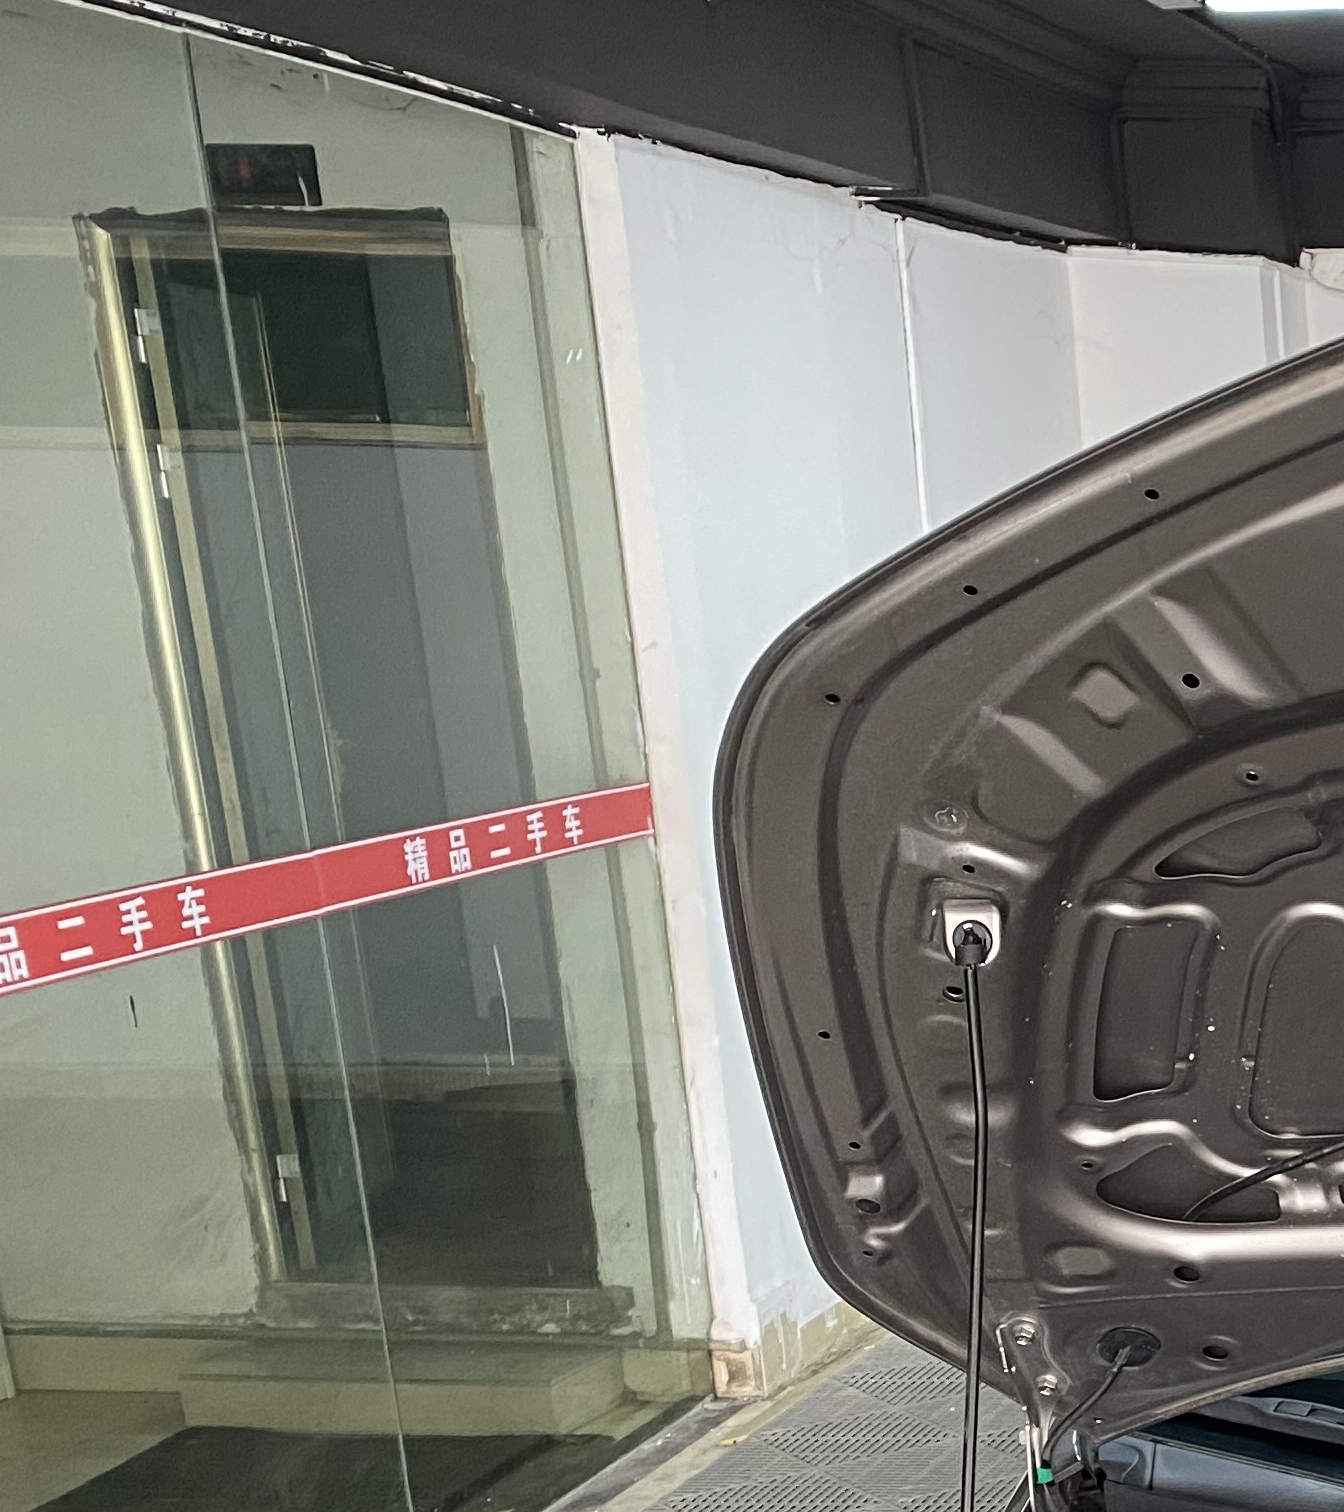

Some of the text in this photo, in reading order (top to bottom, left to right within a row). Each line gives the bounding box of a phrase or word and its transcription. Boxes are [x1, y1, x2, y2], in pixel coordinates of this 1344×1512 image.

[0, 804, 583, 984] 品二手车 精品二手车
